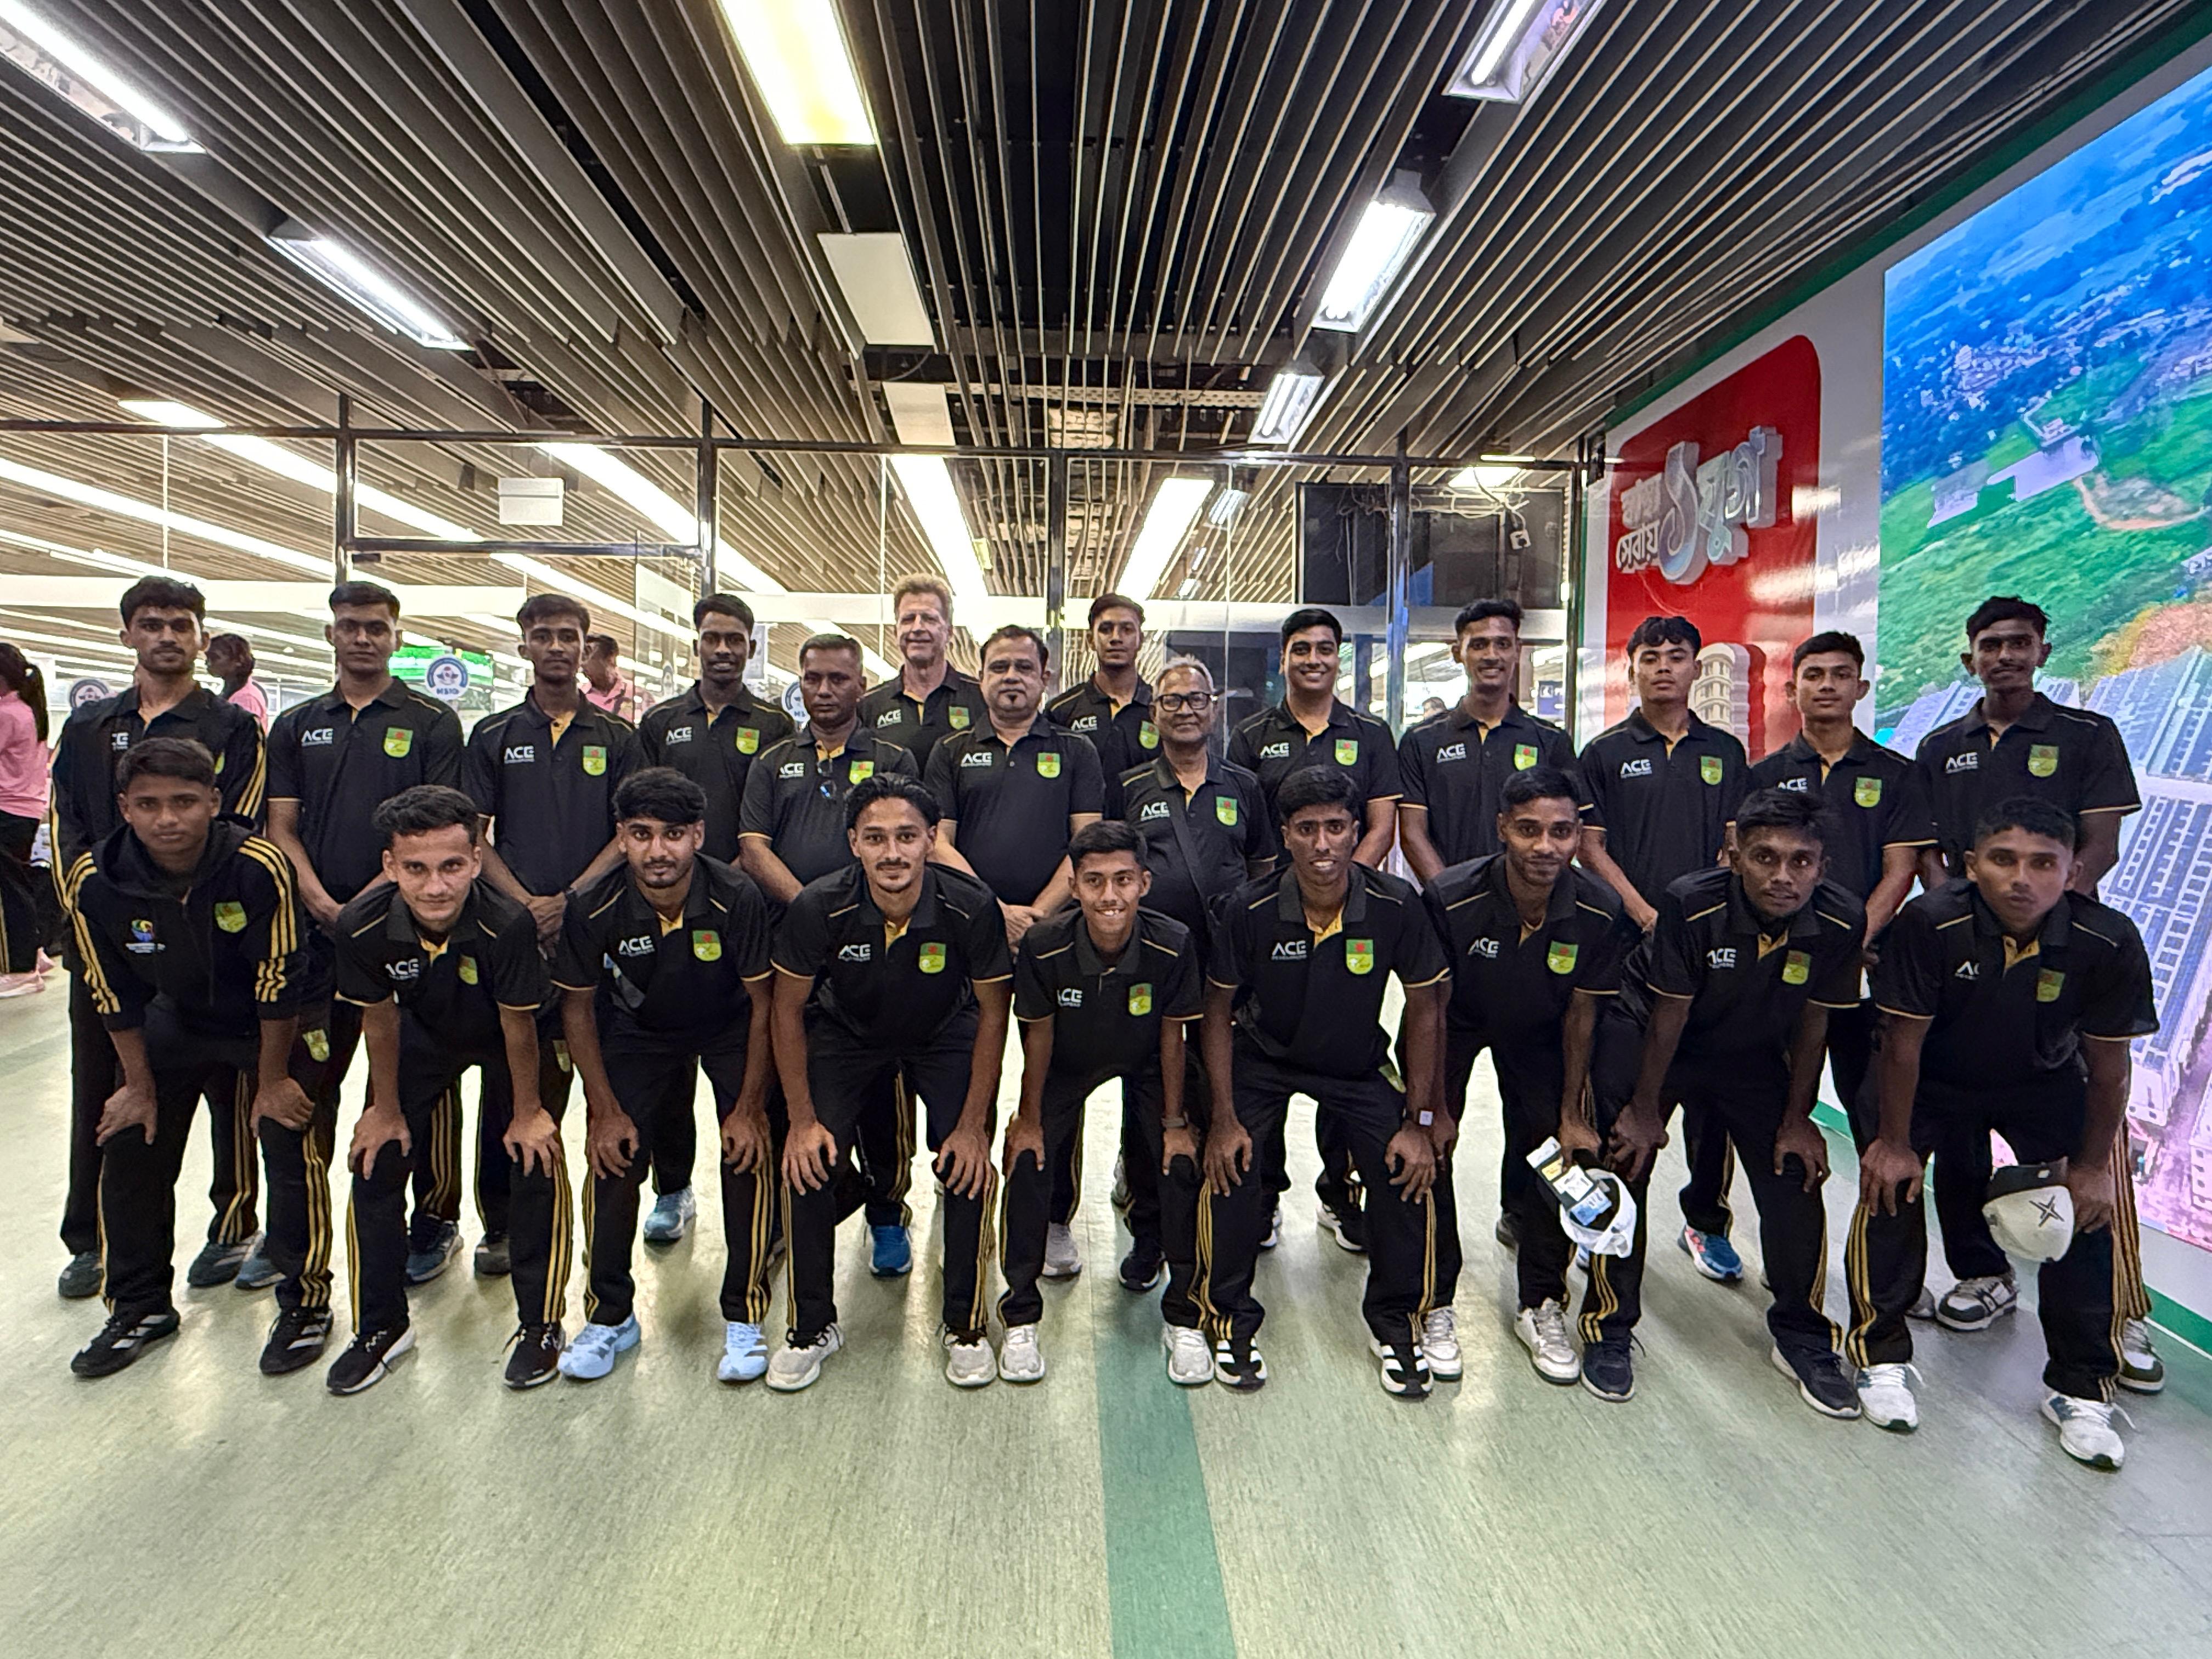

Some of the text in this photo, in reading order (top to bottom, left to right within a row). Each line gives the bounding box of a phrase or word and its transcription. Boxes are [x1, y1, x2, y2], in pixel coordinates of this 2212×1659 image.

[877, 709, 901, 725] ACE
[1071, 716, 1097, 730] ACE
[302, 728, 333, 742] ACE
[666, 726, 692, 742] ACE
[504, 746, 534, 759] ACE
[1260, 742, 1289, 756] ACE
[1437, 743, 1465, 758] ACE
[961, 752, 992, 763] ACE
[1946, 752, 1977, 769] ACE
[1621, 759, 1651, 774] ACE
[1778, 777, 1807, 791] ACE
[1141, 802, 1169, 816] ACE
[619, 935, 653, 953] ACE
[839, 944, 871, 957] ACE
[1272, 940, 1306, 956] ACE
[1468, 938, 1499, 955] ACE
